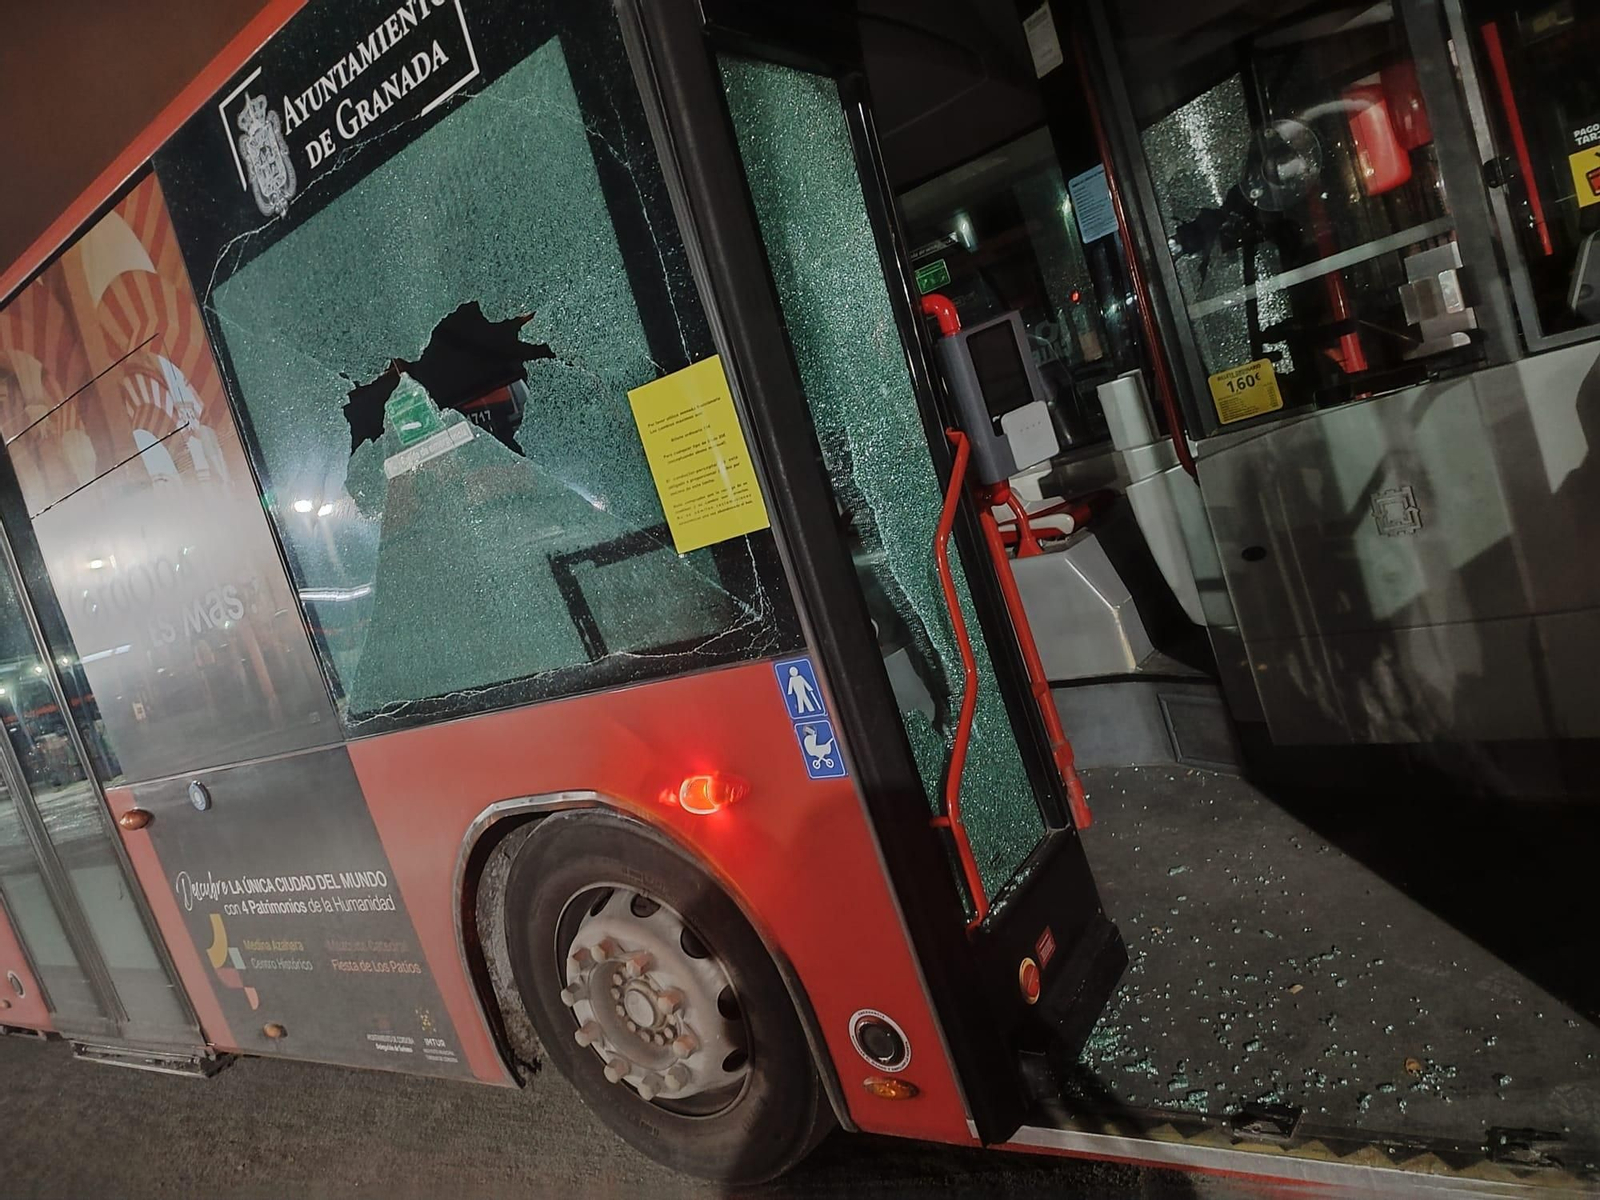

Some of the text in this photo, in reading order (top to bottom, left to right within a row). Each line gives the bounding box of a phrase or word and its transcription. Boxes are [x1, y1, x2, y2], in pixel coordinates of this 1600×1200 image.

[304, 40, 449, 169] DE GRANADA
[1226, 372, 1261, 393] 1,60€
[228, 880, 244, 895] LA
[275, 876, 317, 893] CIUDAD
[316, 873, 341, 890] DEL
[339, 870, 388, 889] MUNDO
[223, 894, 396, 916] con 4 Patrimonios de la Humanidad
[331, 959, 422, 974] Fiesta de Los Patios
